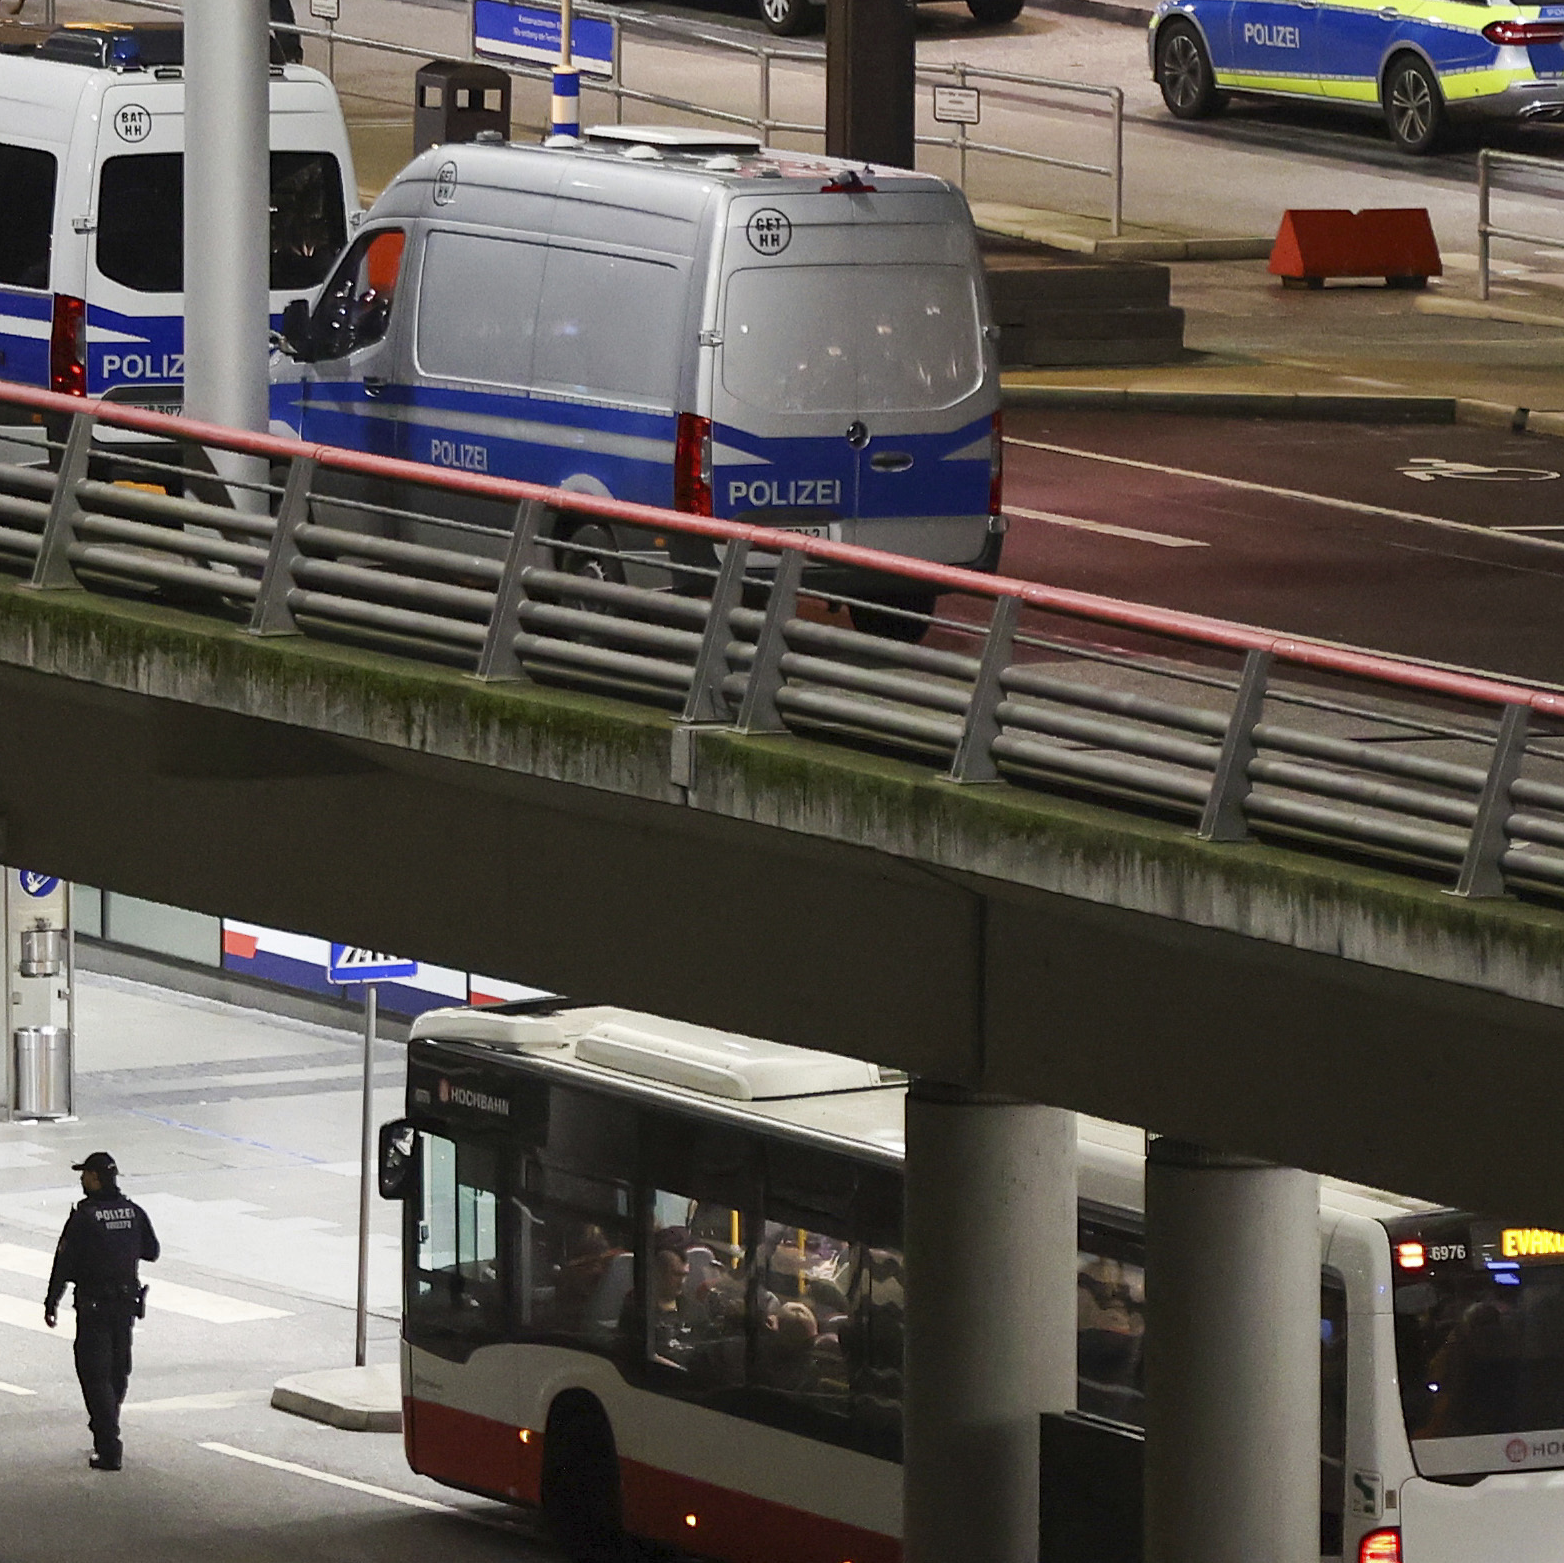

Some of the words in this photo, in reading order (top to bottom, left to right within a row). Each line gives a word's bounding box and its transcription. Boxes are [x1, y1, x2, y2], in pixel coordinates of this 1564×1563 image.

[1244, 22, 1300, 49] POLIZEI
[121, 112, 143, 123] BAT
[125, 125, 142, 136] HH
[756, 218, 782, 231] GET
[760, 234, 780, 248] HH
[432, 439, 488, 471] POLIZEI
[729, 480, 841, 507] POLIZEI
[451, 1086, 510, 1116] HOCHBAHN
[95, 1207, 136, 1221] POLIZEI
[1432, 1245, 1466, 1261] 6976
